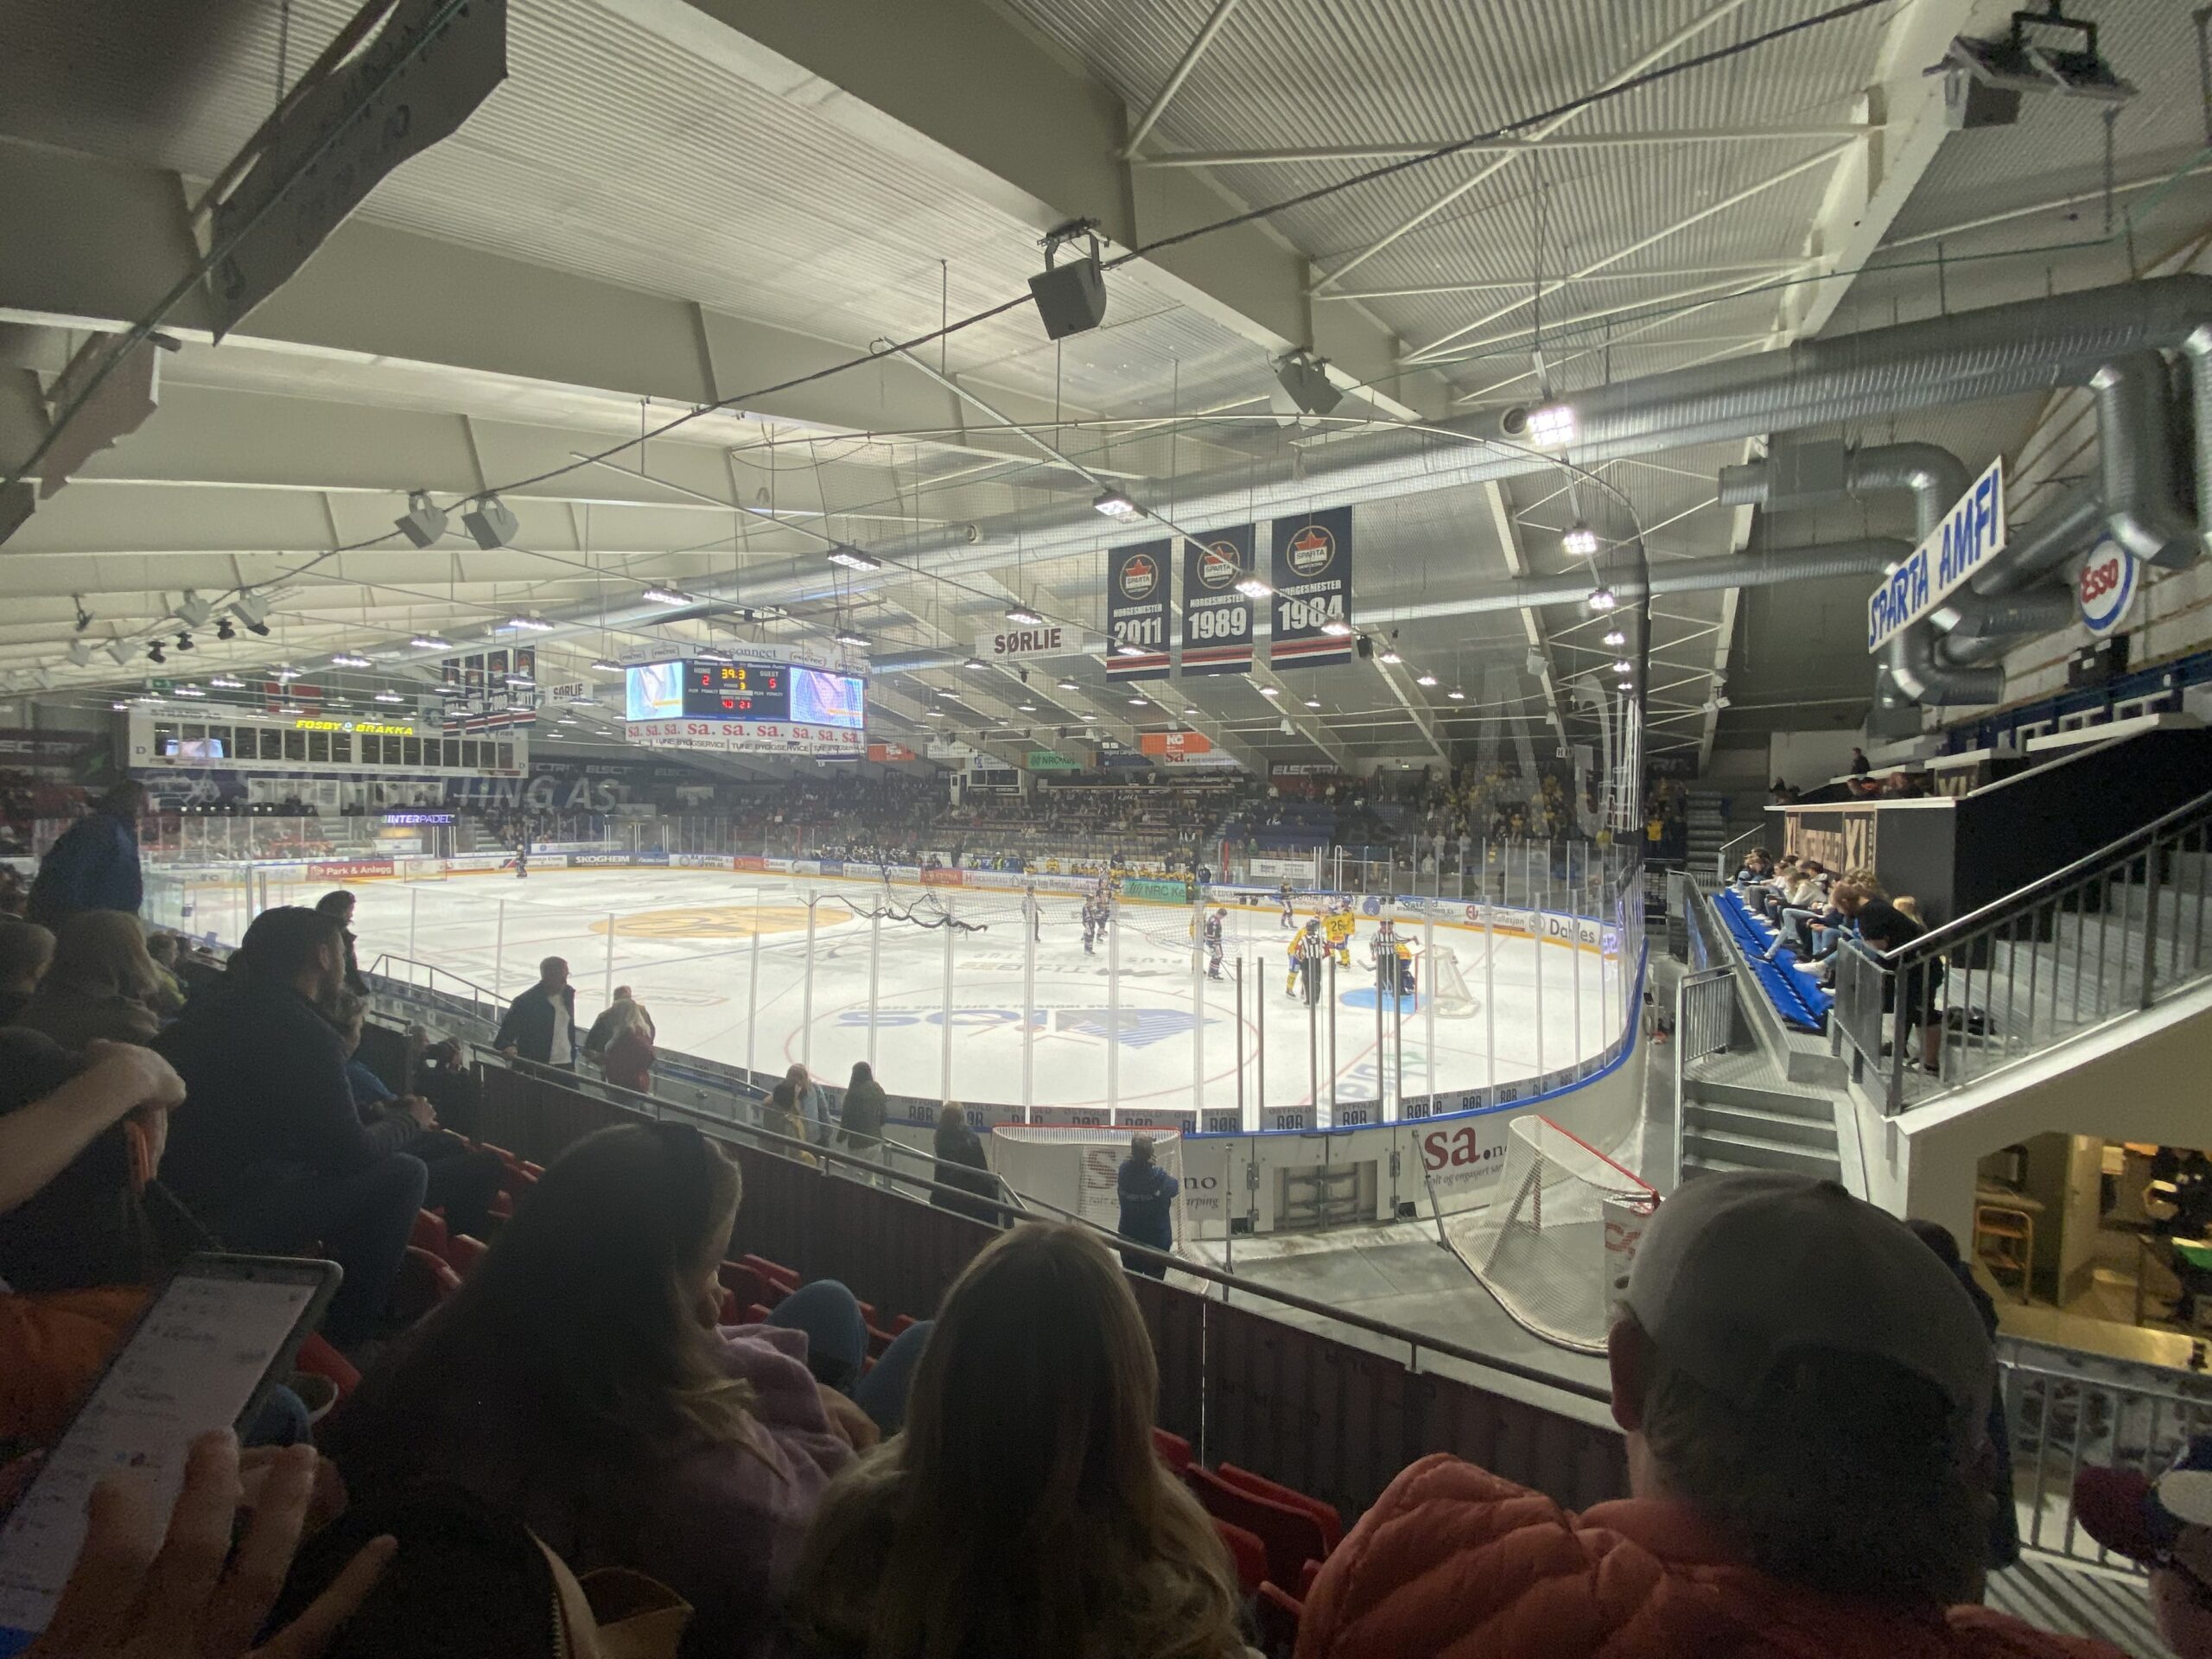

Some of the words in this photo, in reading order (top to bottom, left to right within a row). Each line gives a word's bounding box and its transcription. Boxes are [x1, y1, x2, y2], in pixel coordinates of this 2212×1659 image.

[1296, 549, 1325, 559] SPARTA
[1870, 549, 1929, 646] SPARTA
[1939, 468, 1999, 589] AMFI
[1205, 563, 1231, 574] SPARTA
[1127, 575, 1150, 585] SPARTA
[1279, 580, 1342, 598] NORGESMESTER
[1190, 594, 1244, 608] NORGESMESTER
[1113, 604, 1163, 618] NORGESMESTER
[1278, 594, 1344, 631] 1984
[1188, 607, 1247, 640] 1989
[1114, 617, 1162, 648] 2011
[994, 627, 1061, 654] SØRLIE
[702, 676, 709, 685] 2
[296, 720, 341, 731] FOSBY
[355, 723, 414, 735] BRAKKA
[688, 723, 715, 735] sa.
[722, 724, 750, 736] sa.
[757, 725, 784, 737] sa.
[677, 739, 726, 748] BYGGSERVICE
[755, 743, 810, 753] BYGGSERVICE
[385, 815, 452, 823] INTERPADEL
[575, 855, 630, 864] SKOGHEIM
[326, 868, 349, 876] Park
[359, 865, 391, 876] Anlegg
[1145, 882, 1169, 895] NRC
[1331, 921, 1343, 932] 26
[1501, 1088, 1517, 1103] RØR
[1463, 1096, 1482, 1110] RØR
[909, 1105, 933, 1121] RØR
[1343, 1109, 1366, 1126] RØR
[1211, 1117, 1236, 1132] RØR
[1277, 1115, 1303, 1130] RØR
[1425, 1127, 1507, 1171] sa.n
